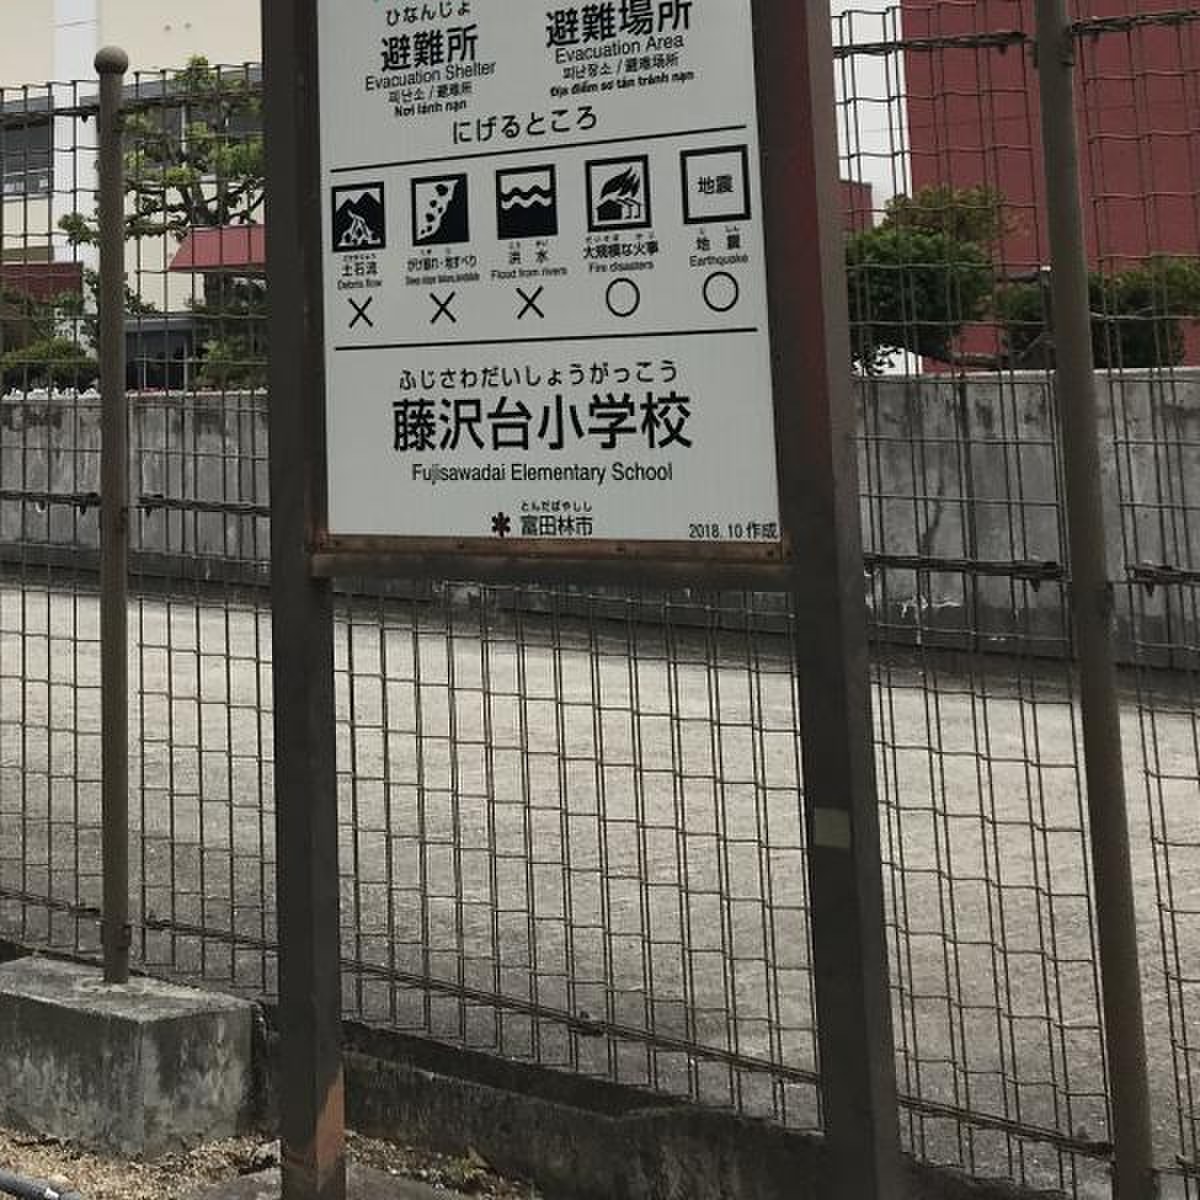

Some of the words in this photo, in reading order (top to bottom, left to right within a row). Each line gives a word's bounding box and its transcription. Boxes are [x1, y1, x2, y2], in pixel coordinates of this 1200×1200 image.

[386, 1, 470, 27] ひなんじょ
[381, 24, 478, 72] 避難所
[555, 40, 641, 64] Evacuation
[646, 34, 684, 51] Area
[365, 69, 441, 91] Evacuation
[445, 61, 497, 81] Shelter
[453, 106, 597, 144] にげるところ
[697, 174, 734, 194] 地震
[689, 253, 749, 268] Earthquake
[399, 360, 678, 390] ふじさわだいしょうがっこう
[392, 391, 693, 451] 藤沢台小学校
[412, 463, 506, 485] Fujisawadai
[511, 463, 606, 486] Elementary
[611, 461, 673, 481] School
[520, 514, 593, 537] 富田林市
